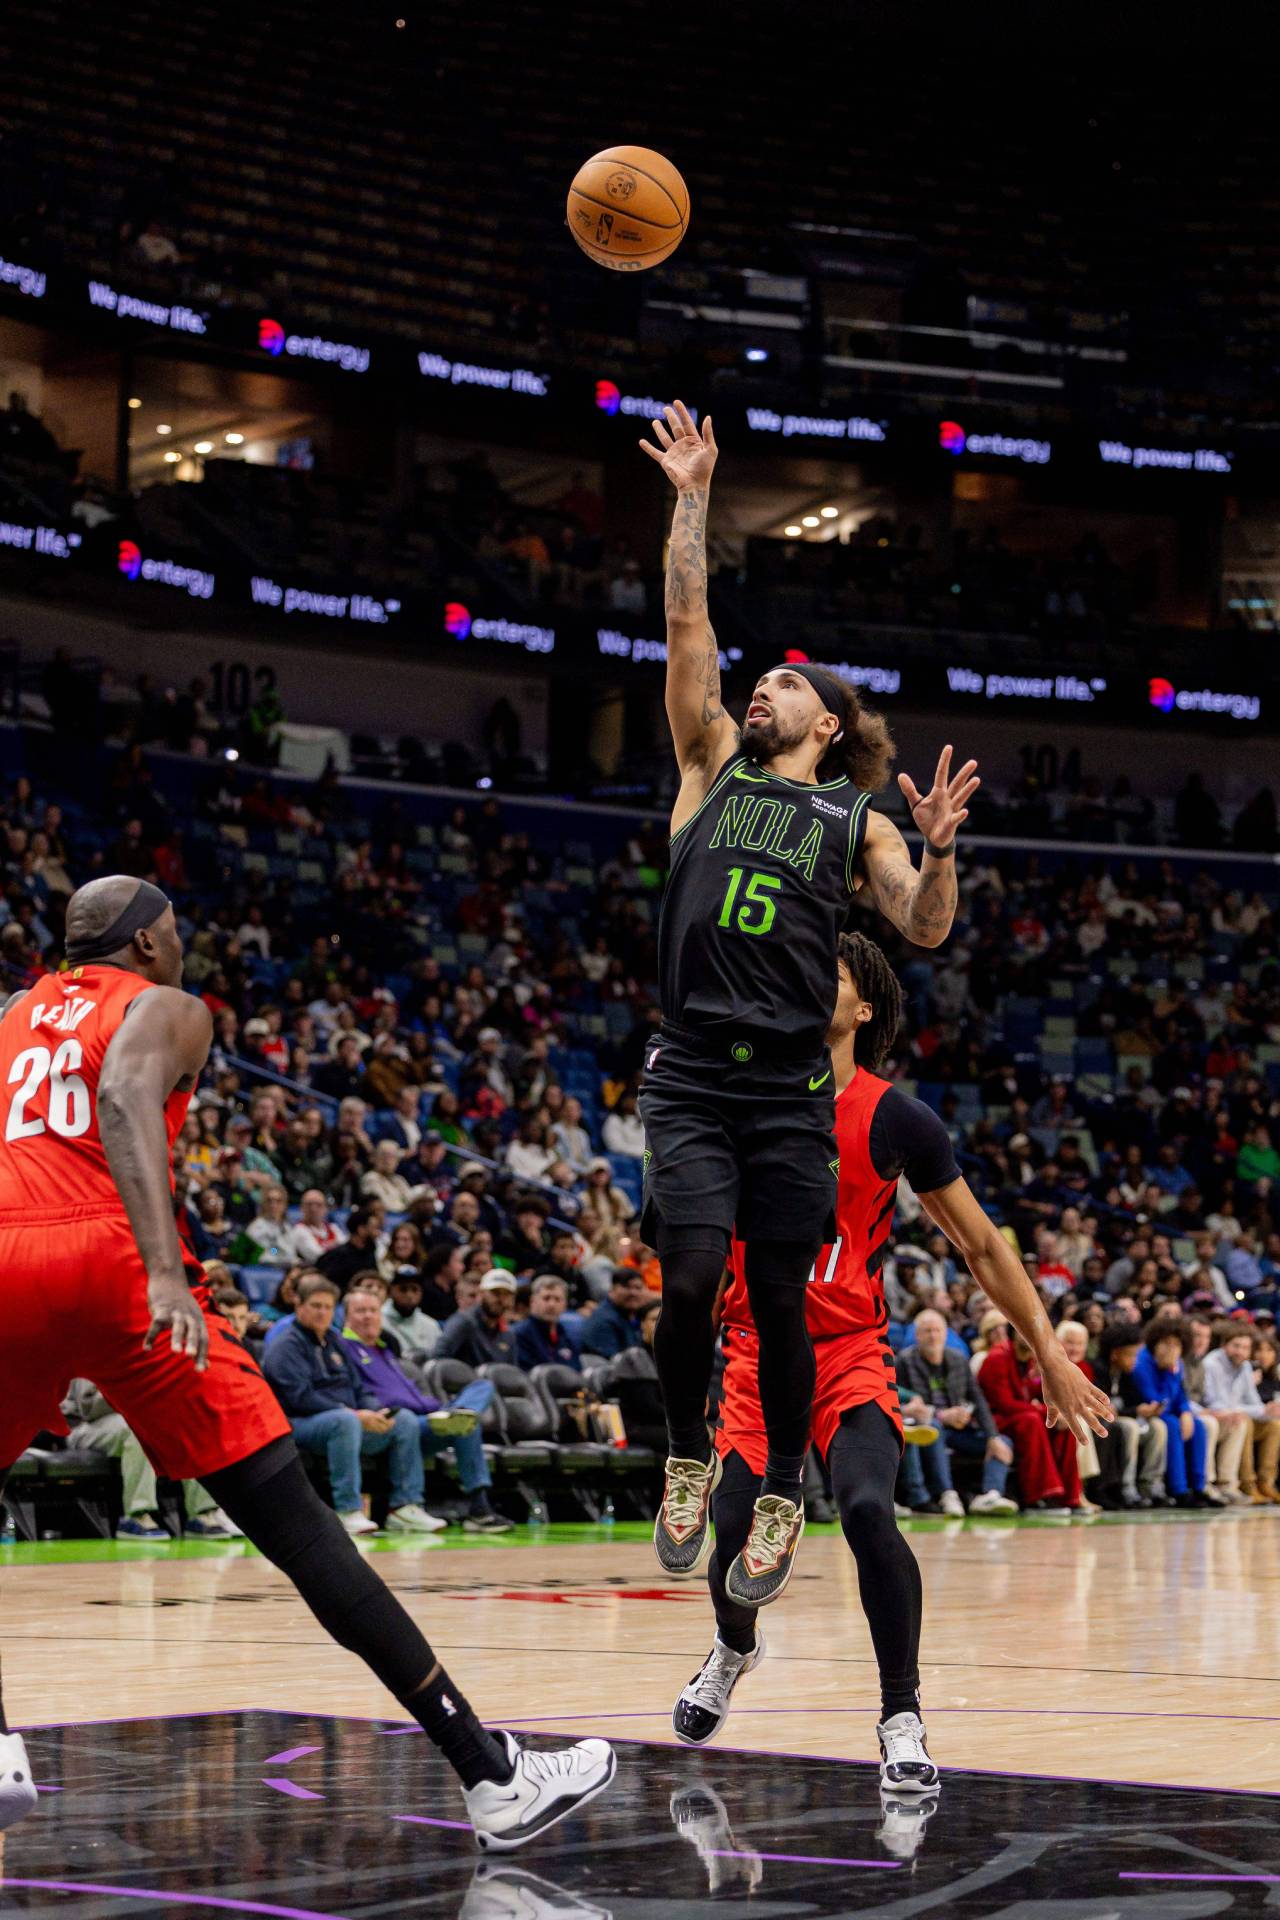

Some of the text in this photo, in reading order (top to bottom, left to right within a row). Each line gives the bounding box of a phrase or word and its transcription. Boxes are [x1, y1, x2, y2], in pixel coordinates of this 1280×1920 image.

[88, 281, 118, 310] We
[117, 294, 169, 326] power
[286, 334, 370, 373] entergy
[418, 351, 451, 379] We
[451, 362, 511, 389] power
[747, 407, 782, 432] We
[782, 415, 847, 438] power
[966, 434, 1051, 464] entergy
[1099, 440, 1133, 464] We
[1133, 448, 1194, 469] power
[141, 559, 215, 599] entergy
[251, 576, 283, 607] We
[284, 588, 350, 618] power
[472, 618, 555, 653] entergy
[597, 628, 632, 657] We
[947, 667, 984, 694] We
[986, 675, 1054, 699] power
[1175, 689, 1260, 720] entergy
[811, 794, 849, 817] NEWAGE
[812, 803, 843, 819] PRODUCTS
[709, 795, 824, 881] NOLA
[718, 867, 781, 935] 15
[5, 1038, 91, 1143] 26
